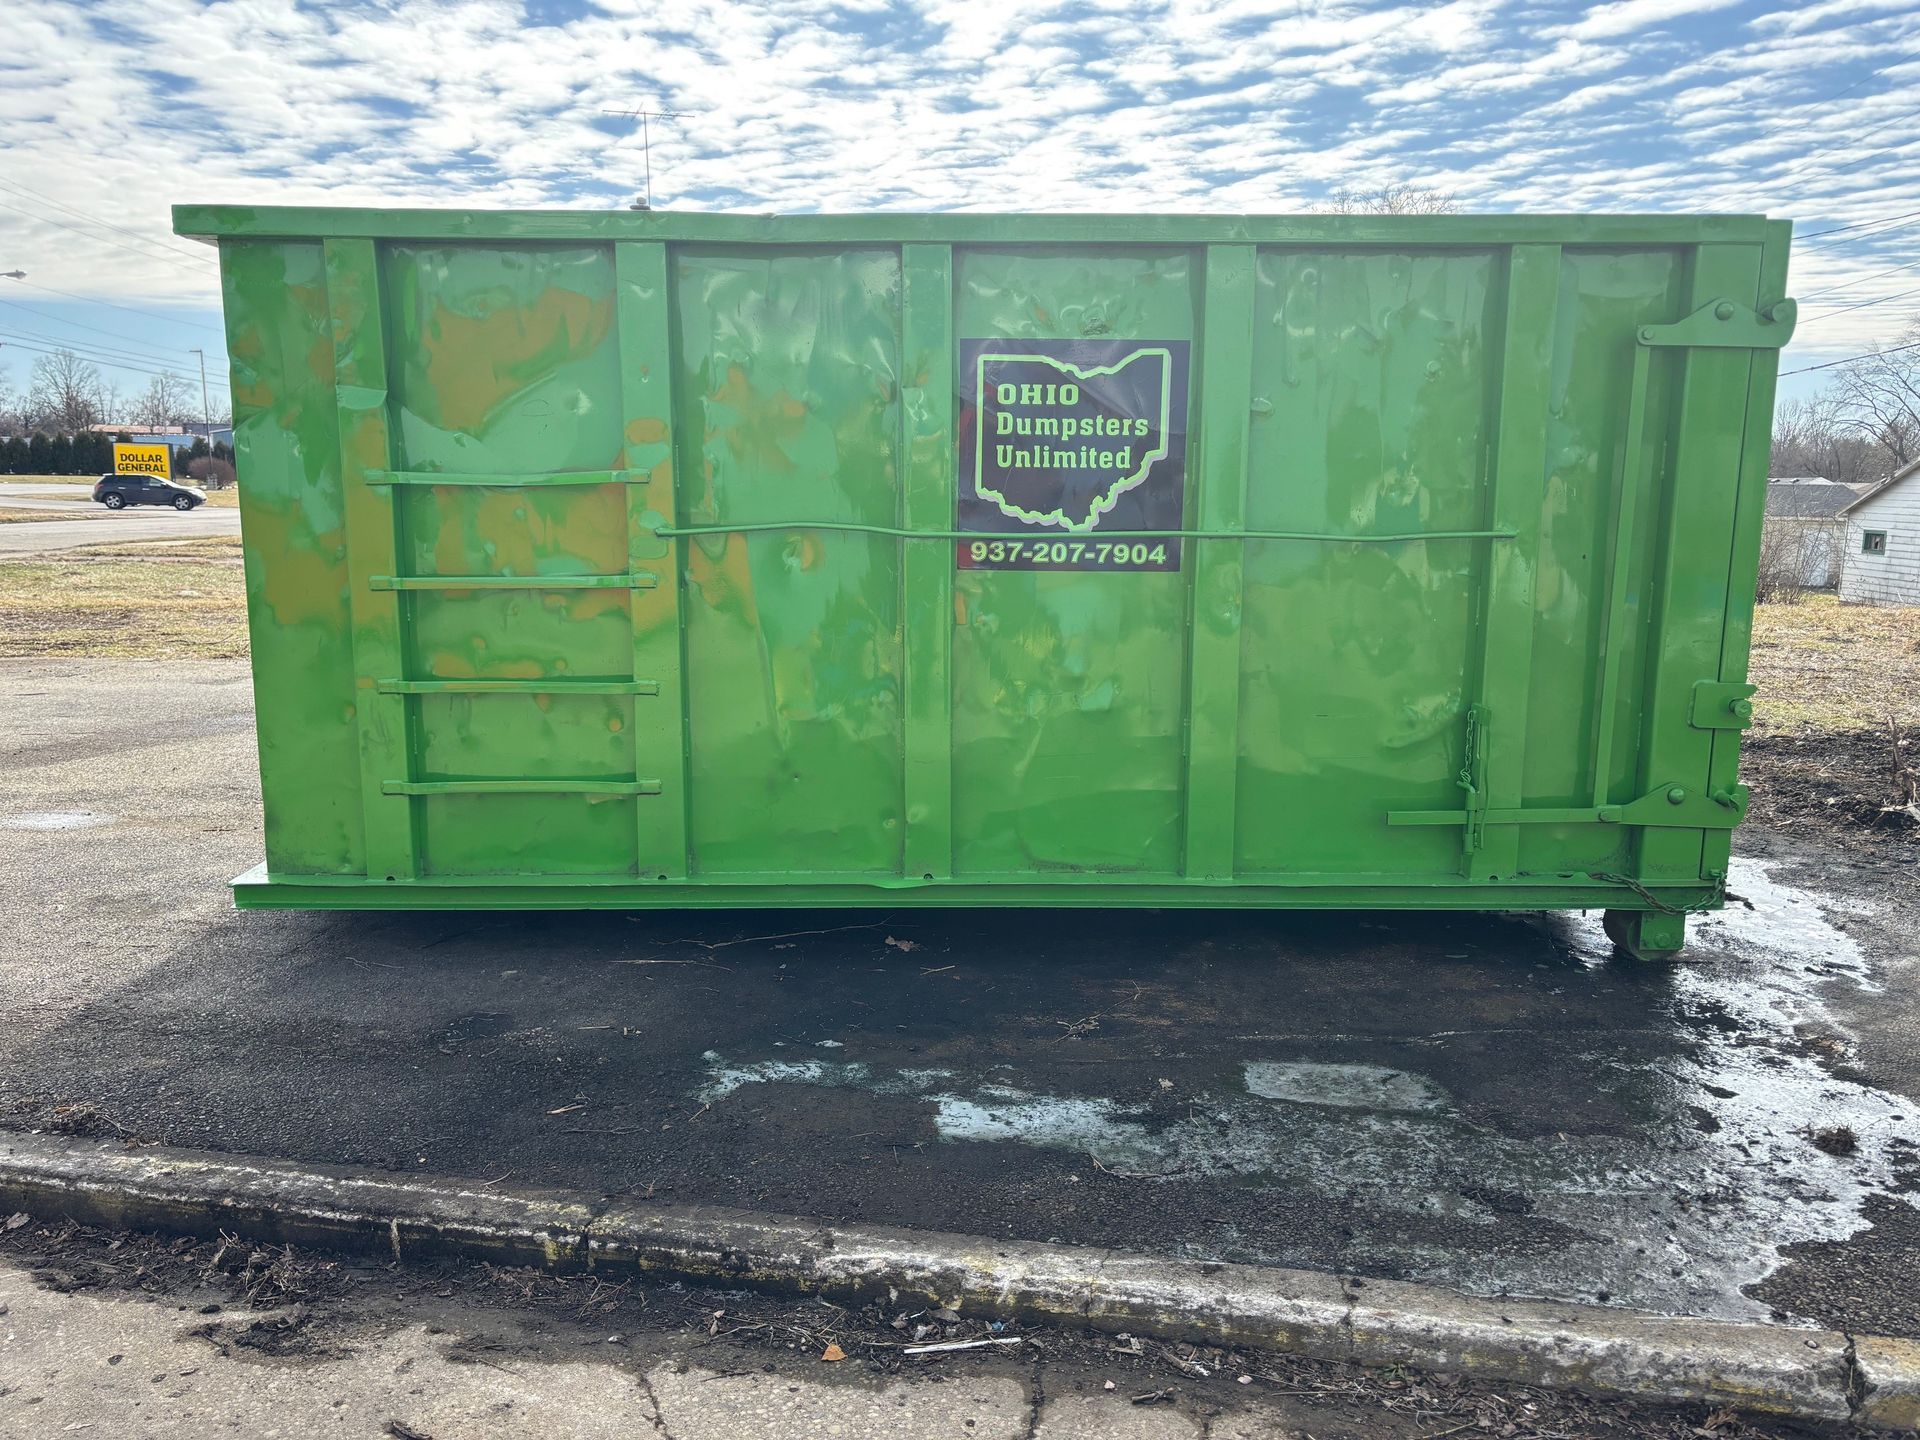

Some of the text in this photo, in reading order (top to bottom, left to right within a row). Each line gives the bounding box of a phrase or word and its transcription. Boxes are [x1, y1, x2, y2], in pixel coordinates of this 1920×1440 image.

[996, 383, 1080, 406] OHIO
[996, 411, 1149, 441] Dumpsters
[117, 463, 167, 472] GENERAL
[120, 453, 163, 462] DOLLAR
[996, 445, 1131, 469] Unlimited
[970, 541, 1166, 564] 937-207-7904
